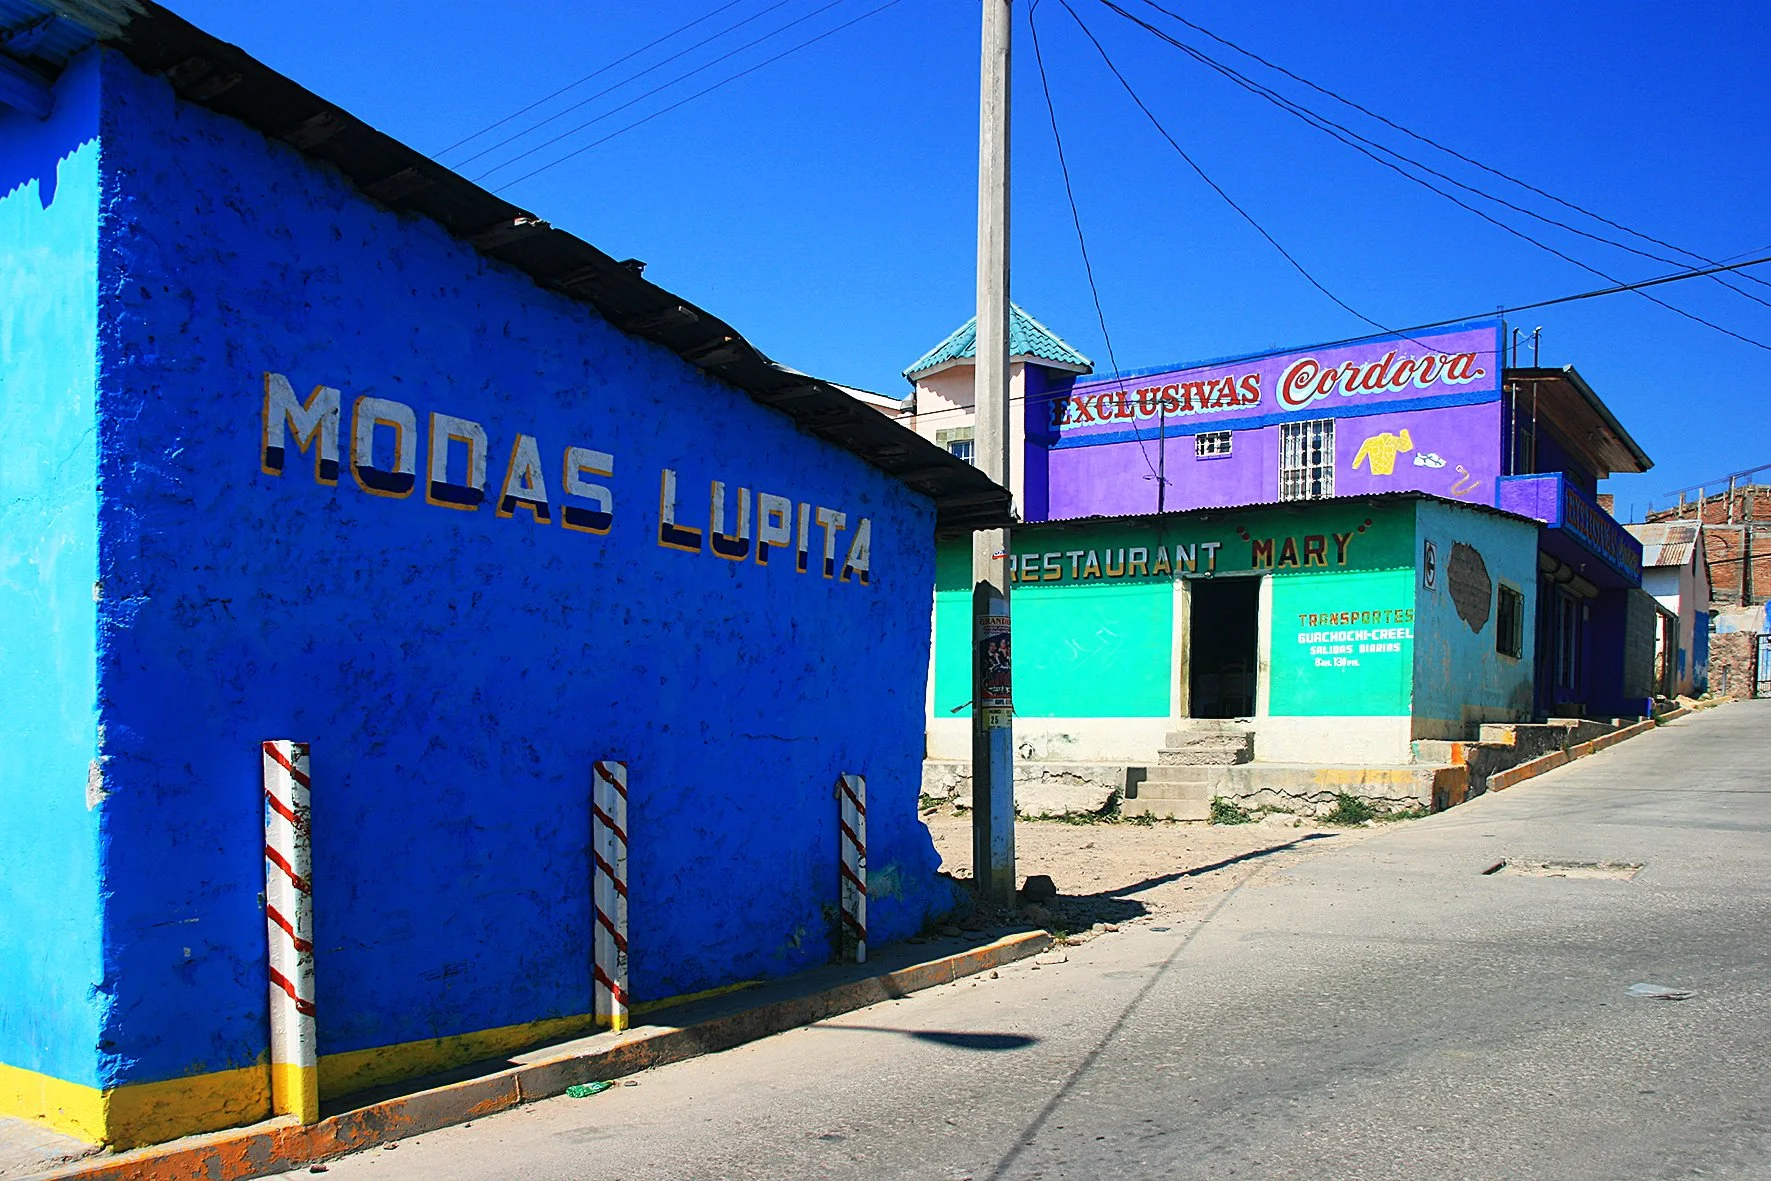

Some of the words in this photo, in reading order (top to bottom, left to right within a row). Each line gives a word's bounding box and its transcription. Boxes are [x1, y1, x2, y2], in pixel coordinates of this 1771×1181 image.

[1051, 373, 1262, 428] EXCLUSIVAS
[1279, 350, 1486, 408] Cordova
[261, 371, 614, 535] MODAS
[658, 468, 872, 586] LUPITA
[1251, 531, 1355, 569] MARY
[1299, 609, 1414, 627] TRANSPORTES
[1297, 628, 1414, 644] GUACHOCHI-CREEL
[1309, 644, 1353, 656] SALIDAS
[1359, 642, 1401, 654] DIARIAS
